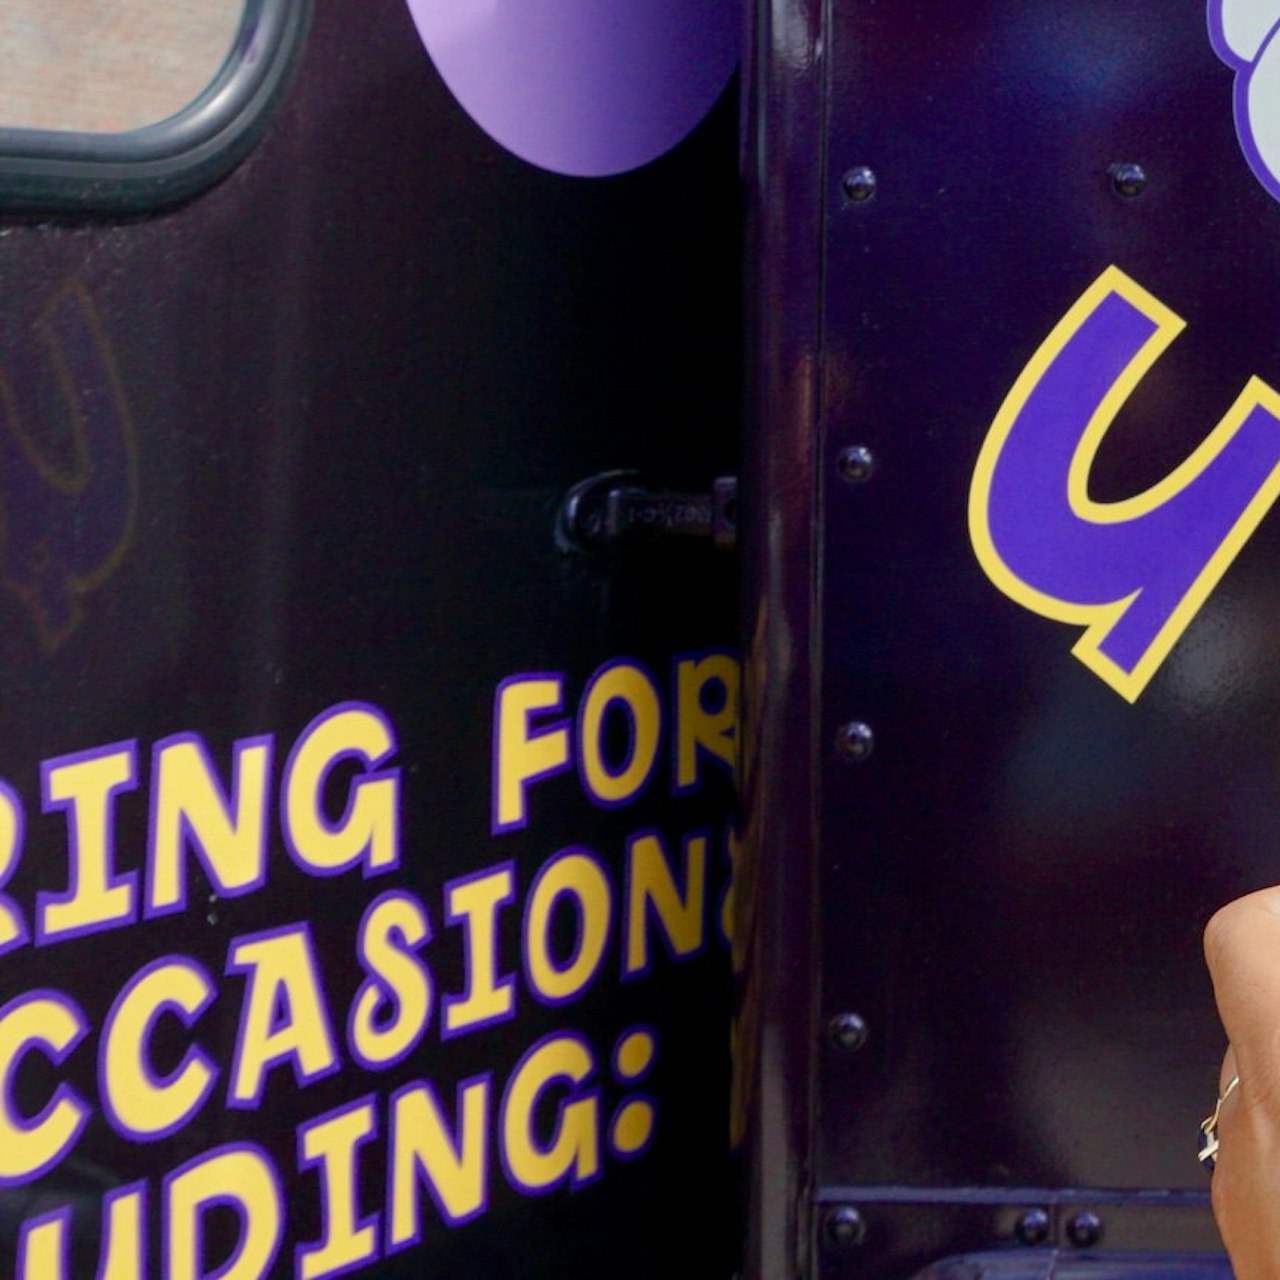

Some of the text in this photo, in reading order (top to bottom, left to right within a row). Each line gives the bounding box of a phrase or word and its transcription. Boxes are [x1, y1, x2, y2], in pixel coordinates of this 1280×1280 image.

[0, 648, 742, 955] ING FOR
[0, 826, 742, 1187] CCASION
